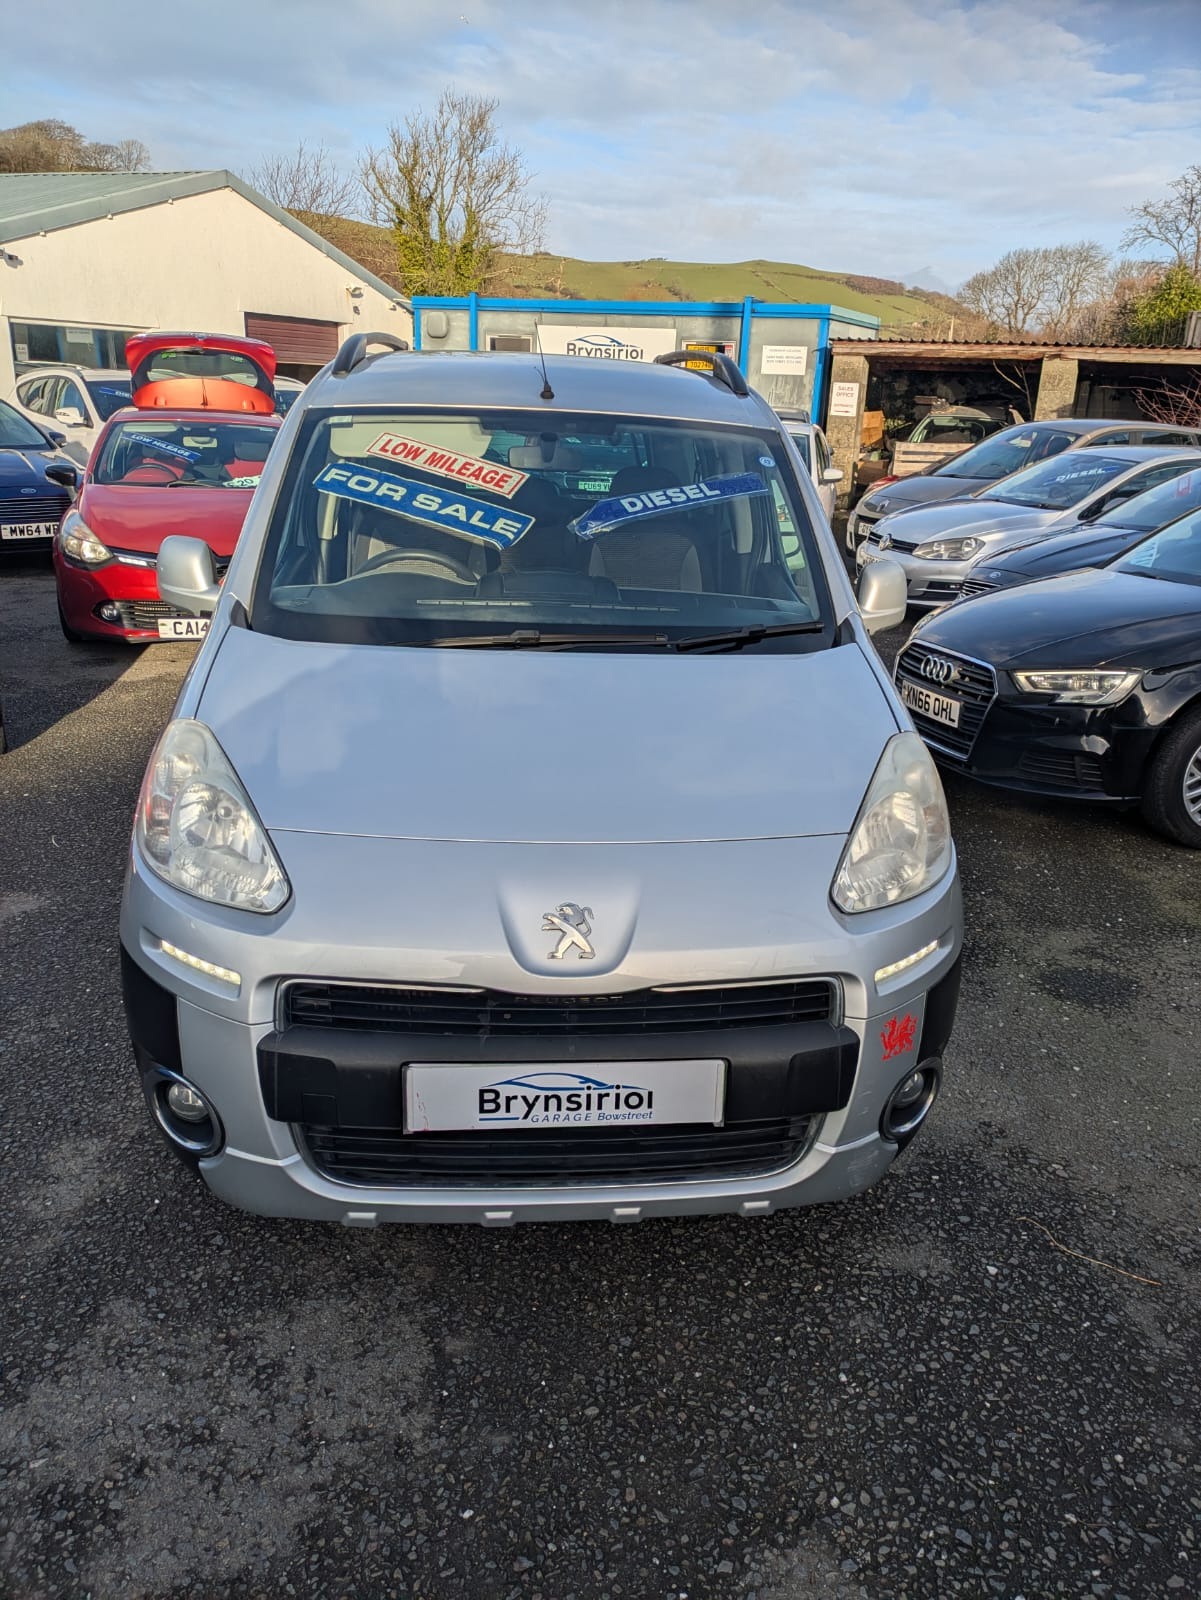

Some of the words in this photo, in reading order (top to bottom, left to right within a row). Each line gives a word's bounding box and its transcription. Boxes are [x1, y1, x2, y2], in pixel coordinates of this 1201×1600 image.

[131, 434, 153, 442] LOW
[151, 440, 191, 457] MILEAGE
[378, 438, 422, 461] LOW
[424, 451, 514, 490] MILEAGE
[1056, 468, 1105, 483] DIESEL
[322, 467, 408, 501] FOR
[412, 492, 522, 541] SALE
[620, 482, 721, 513] DIESEL
[10, 525, 41, 537] MW64
[172, 620, 209, 636] CA14
[906, 684, 931, 713] KN66
[933, 697, 956, 723] OHL
[479, 1084, 654, 1120] Brynsiriol
[531, 1112, 593, 1123] GARAGE
[597, 1110, 654, 1121] Bowstreet
